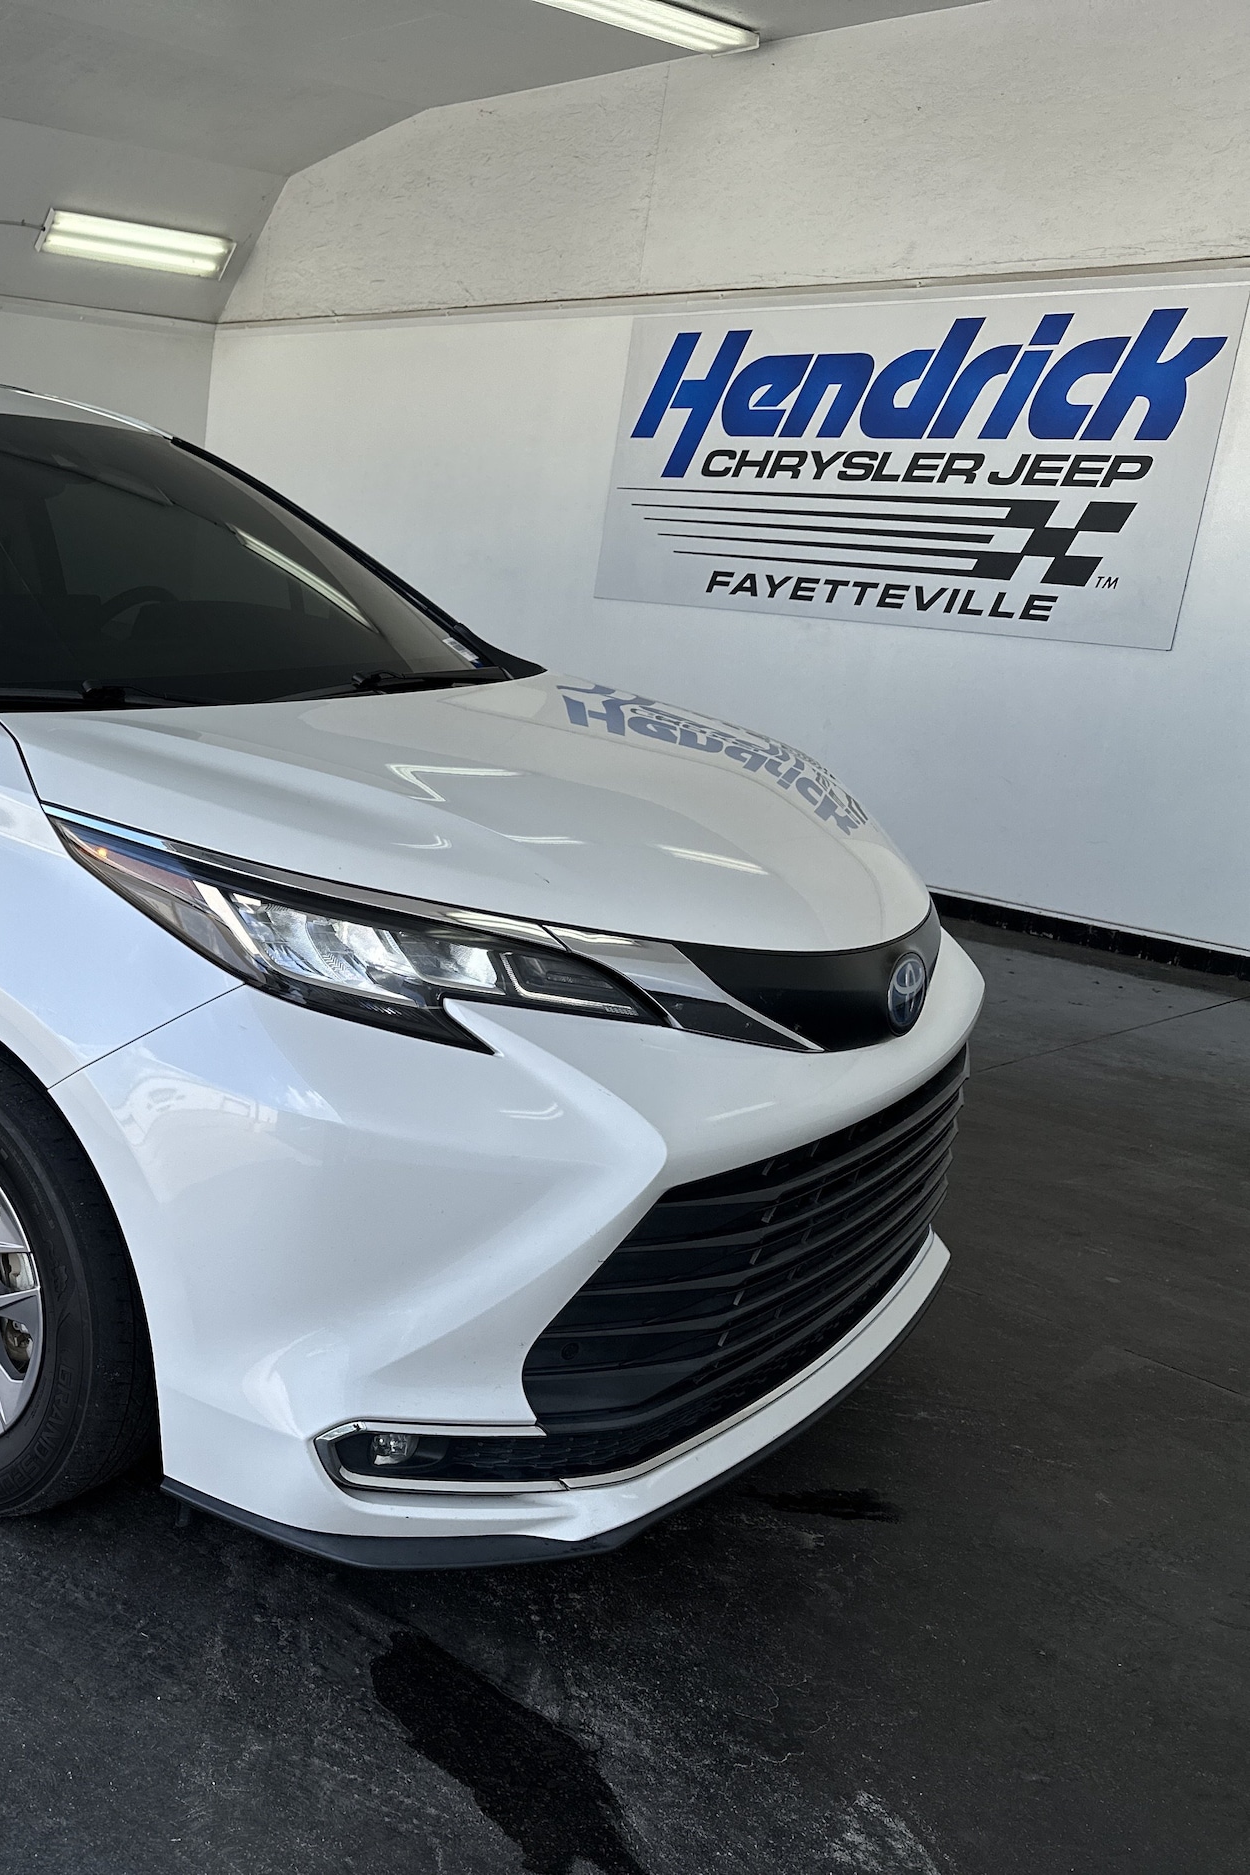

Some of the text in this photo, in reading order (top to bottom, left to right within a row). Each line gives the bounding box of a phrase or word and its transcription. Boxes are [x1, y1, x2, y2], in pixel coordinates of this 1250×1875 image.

[630, 308, 1228, 478] Hendrick
[700, 449, 1154, 488] CHRYSLER JEEP
[705, 570, 1059, 622] FAYETTEVILLE
[34, 1363, 76, 1463] GRAND
